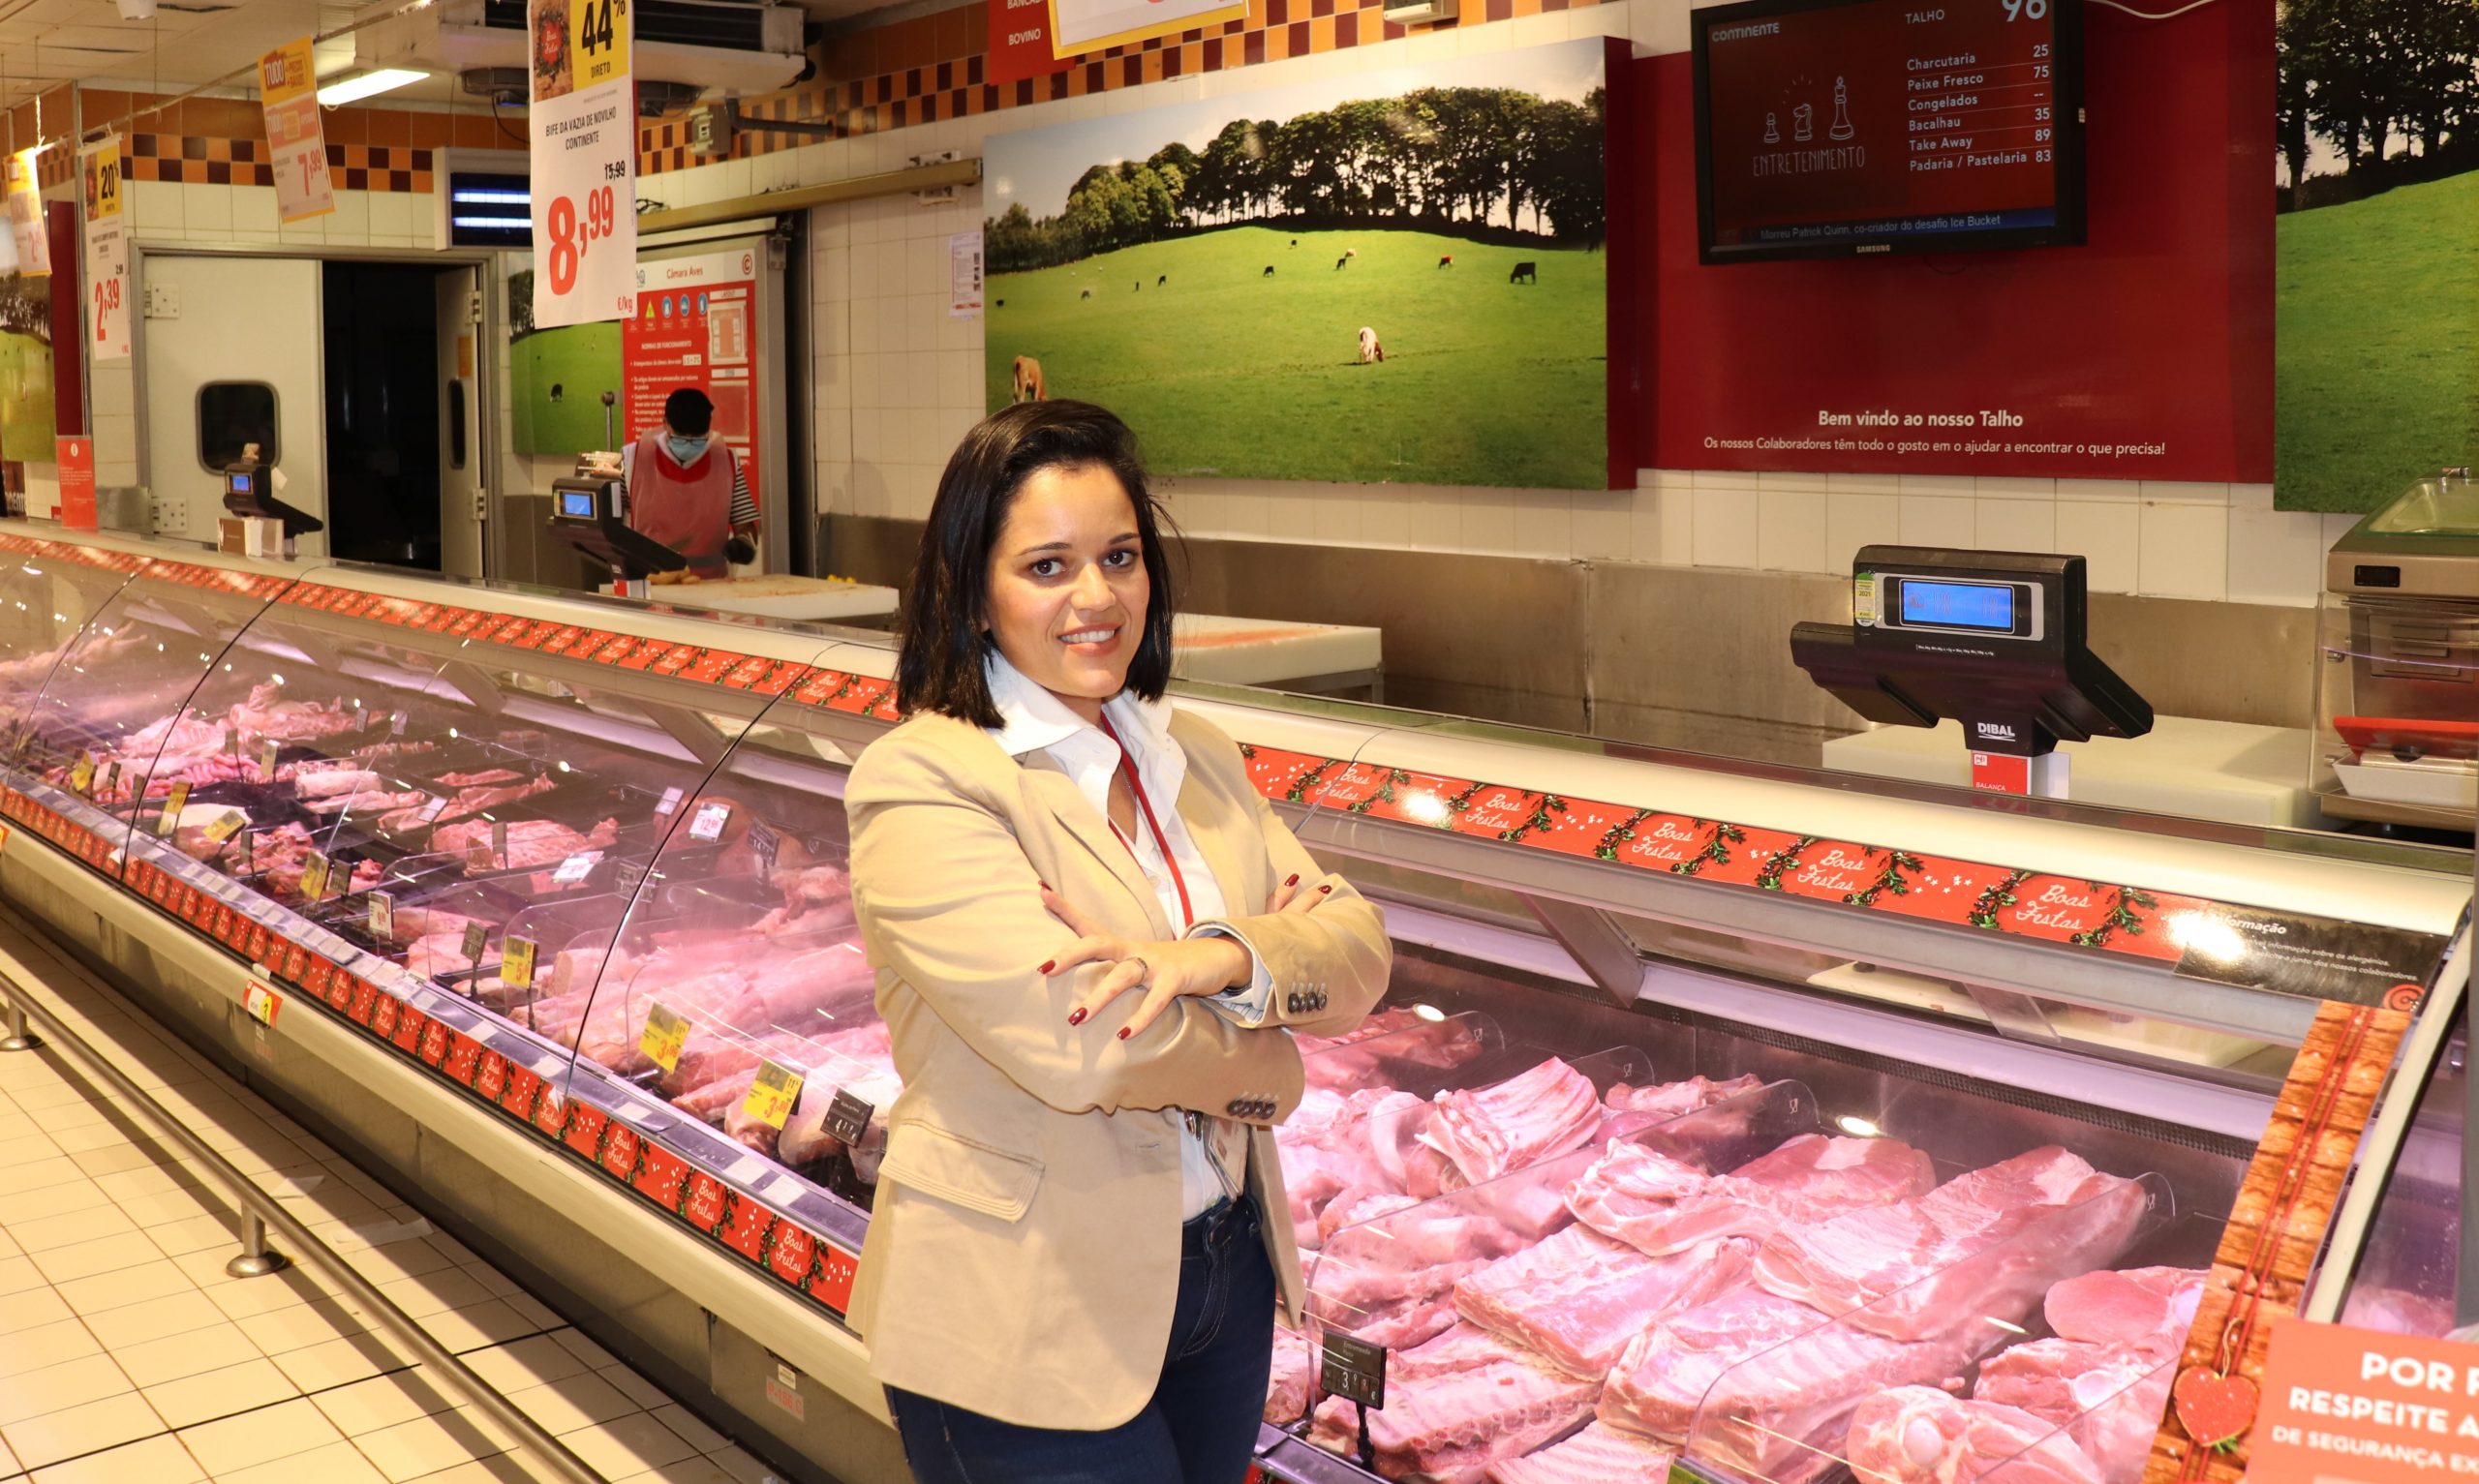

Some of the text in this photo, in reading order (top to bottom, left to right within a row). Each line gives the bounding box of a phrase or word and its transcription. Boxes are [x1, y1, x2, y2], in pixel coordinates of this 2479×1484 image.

[1906, 9, 1945, 24] TALHO
[1008, 28, 1041, 45] BOVINO
[1712, 22, 1780, 42] CONTINENTE
[1907, 44, 2049, 71] Charcutaria 25
[264, 59, 286, 87] TUDO
[591, 62, 611, 78] DIRETO
[1908, 66, 2049, 91] Peixe Fresco 75
[1908, 95, 1978, 111] Congelados
[545, 106, 617, 136] BIFE DA VAZIA DE NOVILHO
[1909, 107, 2050, 132] Bacalhau 35
[566, 131, 599, 150] CONTINENTE
[1909, 129, 2051, 152] Take Away 89
[1753, 145, 1865, 177] ENTRETENIMENTO
[1910, 158, 1953, 171] Padaria
[1967, 151, 2027, 167] Pastelaria
[2035, 149, 2051, 163] 83
[298, 150, 322, 197] 7,99
[1792, 227, 1821, 238] Patrick
[1853, 221, 1899, 234] co-criador
[1901, 220, 1913, 231] do
[1914, 218, 1948, 230] desafio
[1950, 217, 1965, 227] Ice
[1968, 215, 2001, 227] Bucket
[547, 185, 614, 295] 8,99
[1856, 244, 1890, 254] SAMSUNG
[95, 279, 119, 341] 2,39
[1819, 409, 2024, 427] Bem vindo ao nosso Talho
[1704, 437, 2165, 458] Os nossos Colaboradores têm todo o gosto em o ajudar a encontrar o que precisa!
[1977, 722, 2015, 738] DIBAL
[1975, 782, 2005, 792] BALANÇA
[1485, 793, 1521, 812] Boas
[1464, 806, 1511, 829] Festas
[1653, 822, 1693, 842] Boas
[1632, 835, 1682, 861] Festas
[1821, 849, 1865, 871] Boas
[1798, 864, 1854, 891] Festas
[2039, 885, 2092, 907] Boas
[2016, 900, 2083, 929] Festas
[783, 1228, 804, 1252] Boas
[2361, 1351, 2455, 1393] POR
[2288, 1386, 2449, 1434] RESPEITE
[2272, 1425, 2302, 1444] DE
[2307, 1431, 2444, 1469] SEGURANÇA
